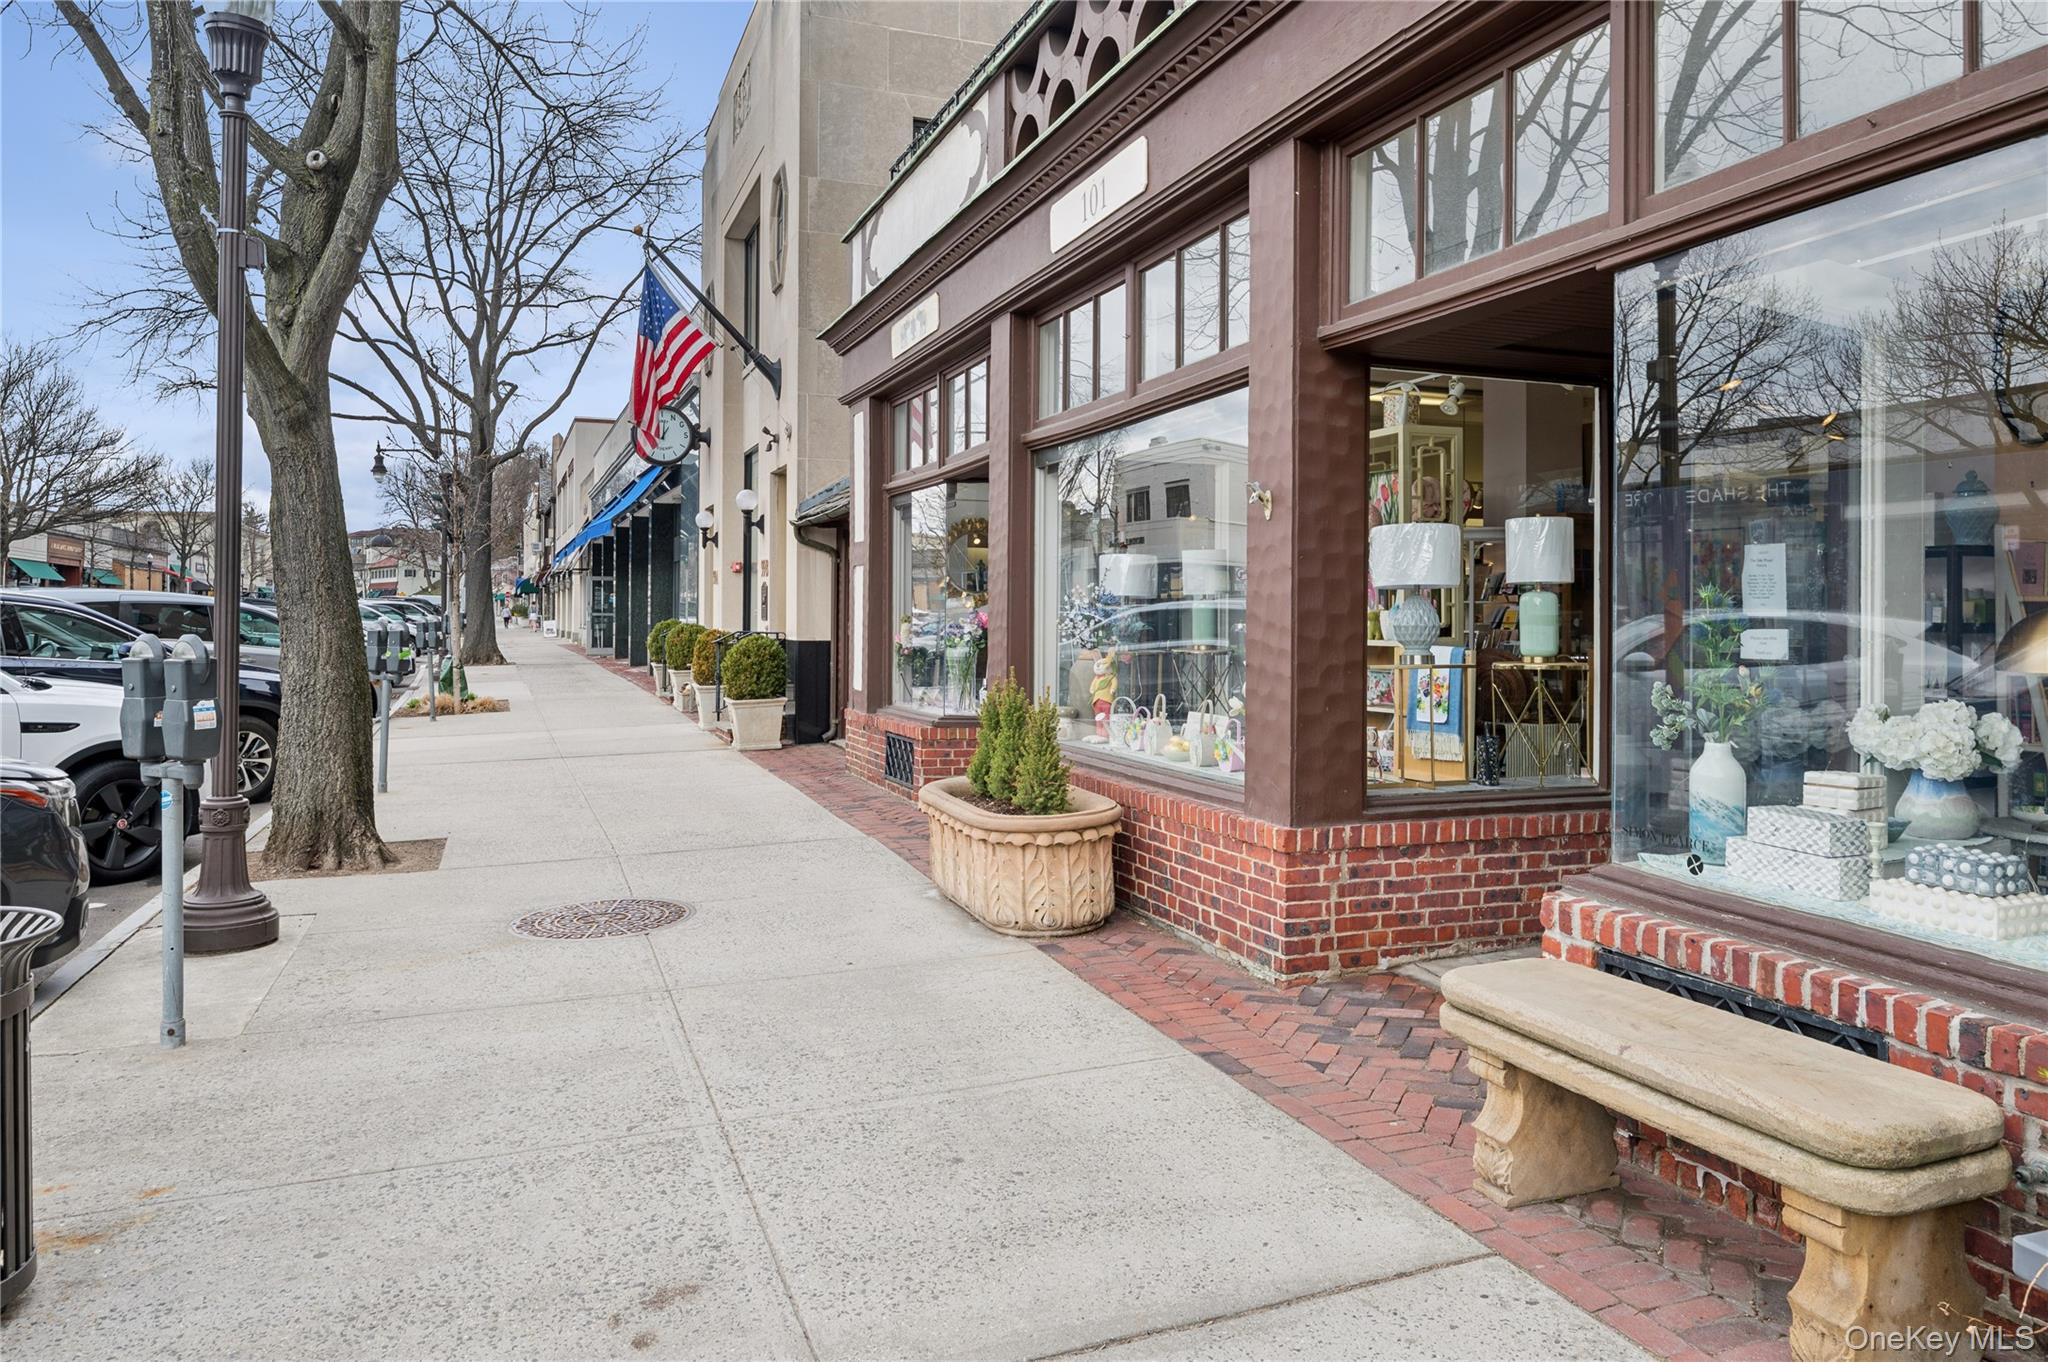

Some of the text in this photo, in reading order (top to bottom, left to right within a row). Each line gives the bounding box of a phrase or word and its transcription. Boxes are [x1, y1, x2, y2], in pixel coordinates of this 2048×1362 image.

[1081, 176, 1107, 224] 101
[1622, 826, 1710, 852] SIMON PEARCE
